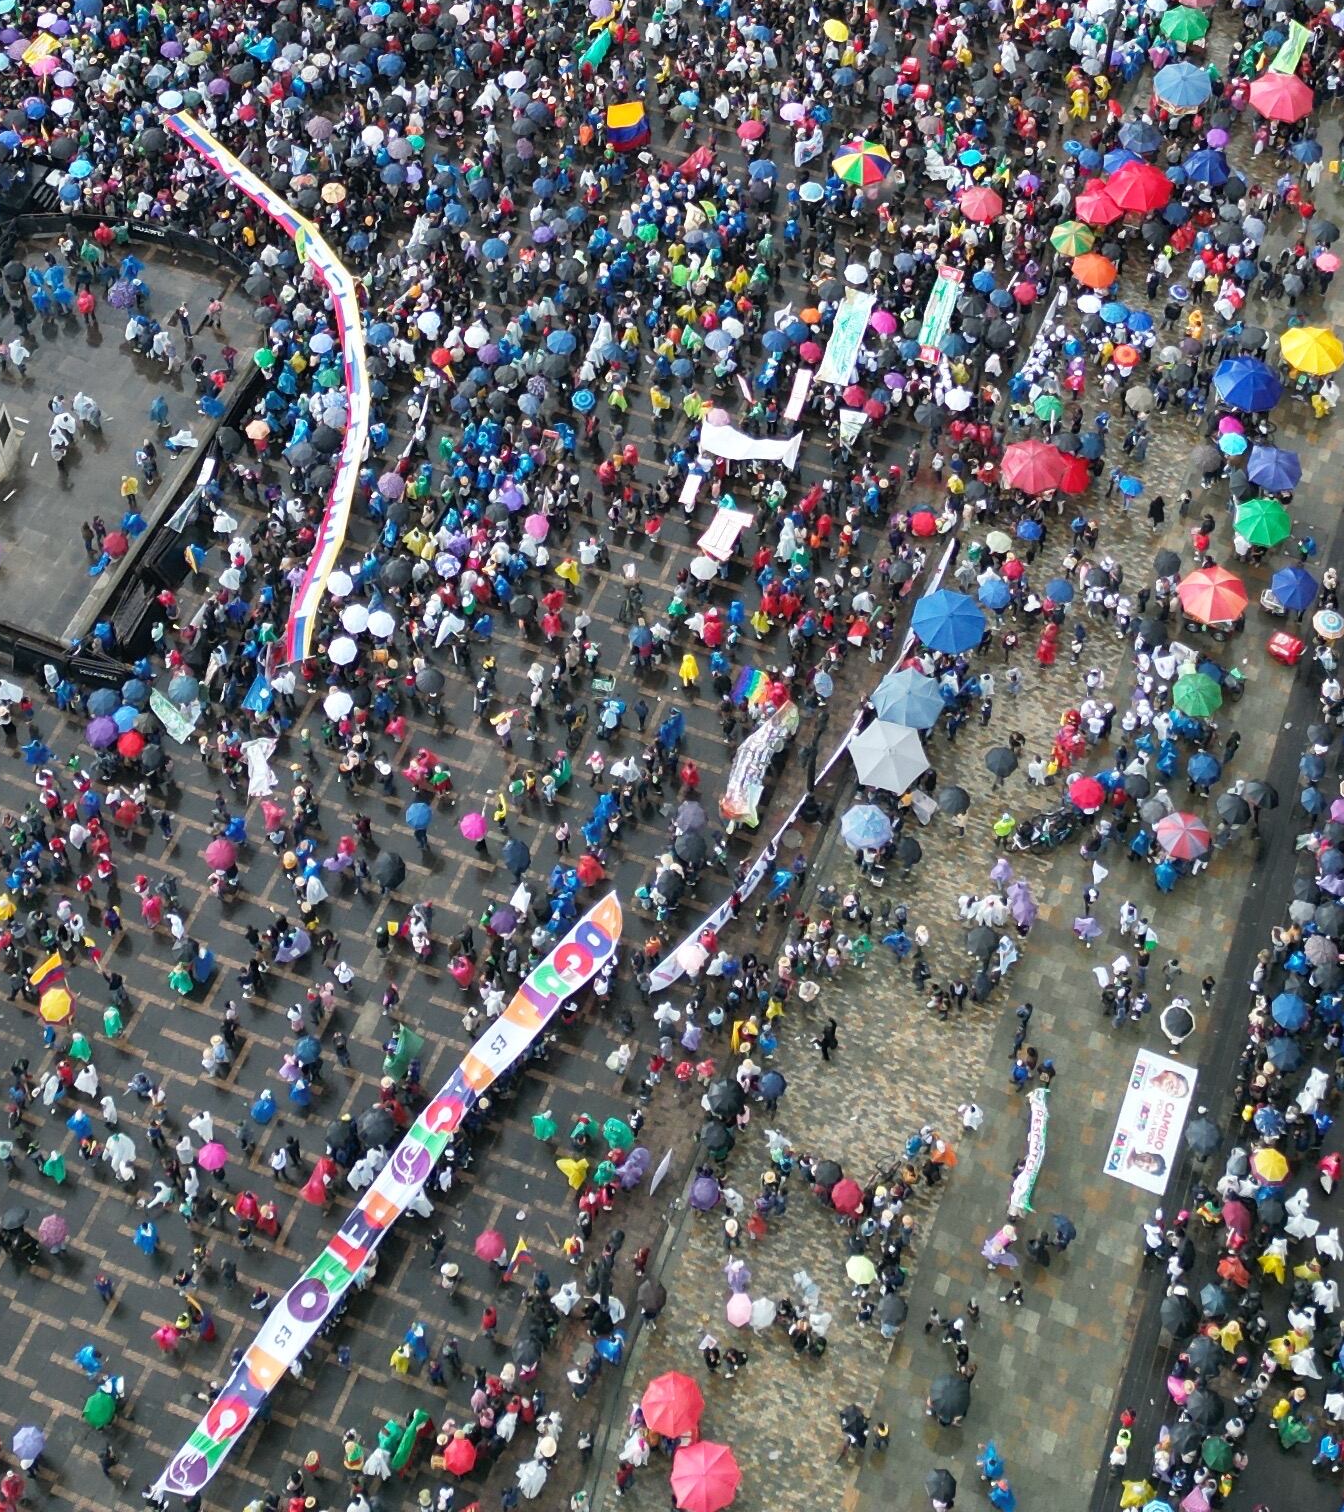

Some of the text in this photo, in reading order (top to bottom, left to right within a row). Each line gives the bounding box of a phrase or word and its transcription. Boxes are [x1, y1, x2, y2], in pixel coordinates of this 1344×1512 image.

[487, 1033, 510, 1056] ES
[389, 1053, 496, 1185] PACTO
[1152, 1101, 1176, 1151] CAMBIO
[287, 1189, 400, 1319] PETRO
[270, 1323, 294, 1349] ES
[165, 1344, 286, 1495] PACTO
